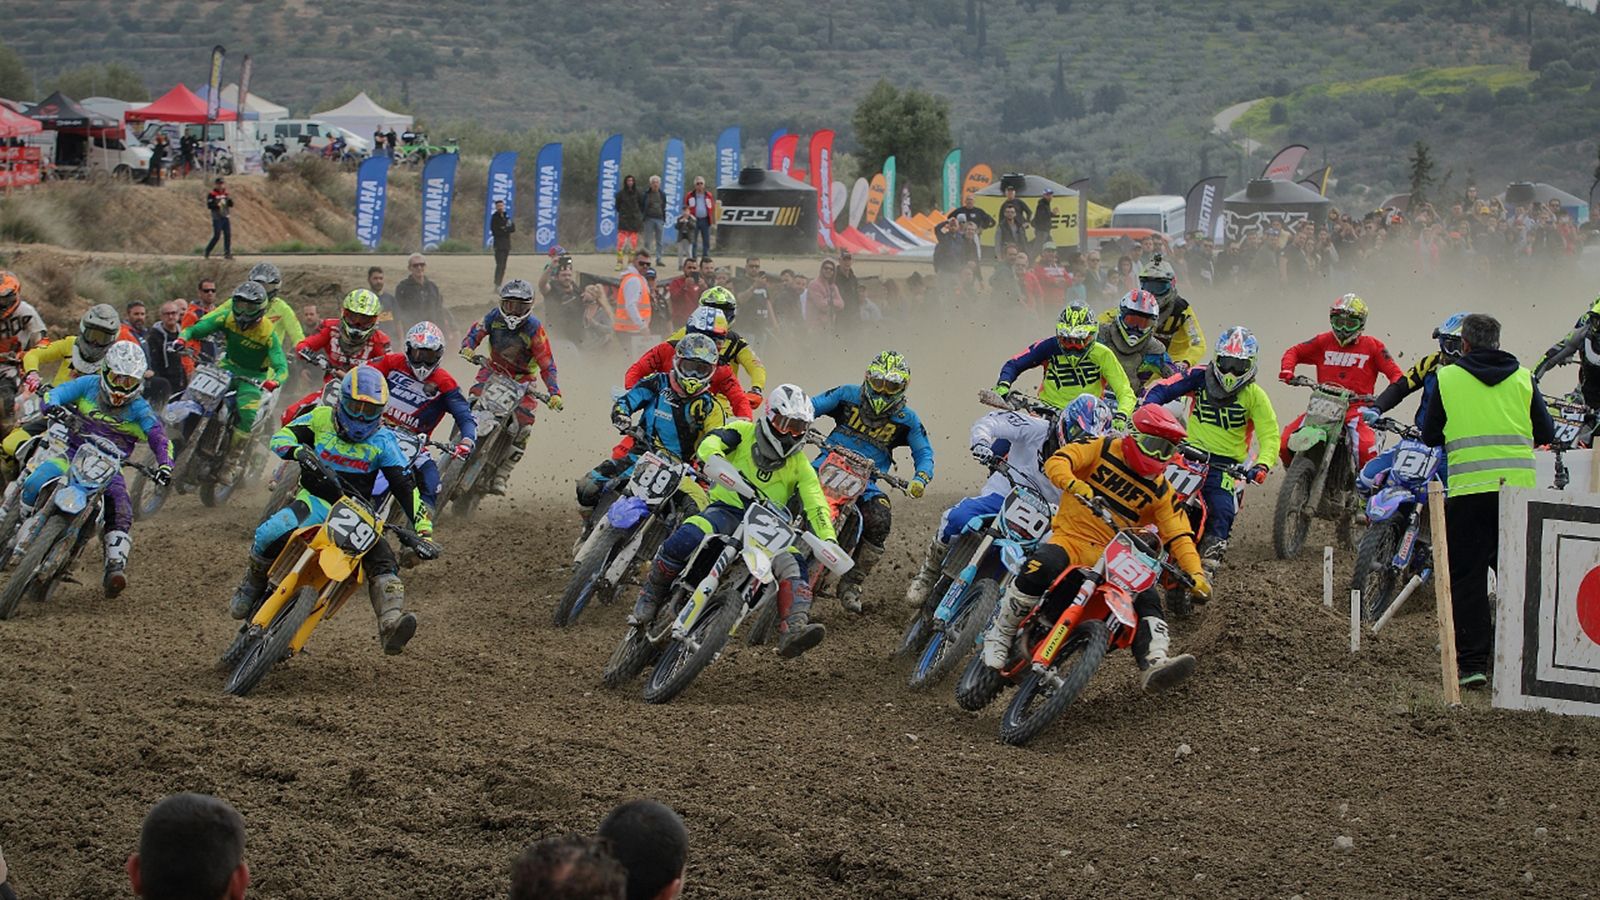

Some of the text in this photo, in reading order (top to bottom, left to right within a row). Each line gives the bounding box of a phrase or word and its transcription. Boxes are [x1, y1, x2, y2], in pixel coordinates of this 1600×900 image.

[537, 165, 555, 229] YAMAHA
[600, 158, 616, 218] YAMAHA
[665, 156, 679, 216] YAMAHA
[357, 180, 378, 247] YAMAHA
[423, 178, 445, 245] YAMAHA
[721, 209, 774, 222] SPY
[1323, 350, 1370, 369] SHIFT
[387, 408, 420, 429] AMAHA
[1090, 464, 1153, 510] SHIFT
[328, 507, 377, 551] 29
[748, 513, 792, 551] 21
[1107, 552, 1151, 588] 161
